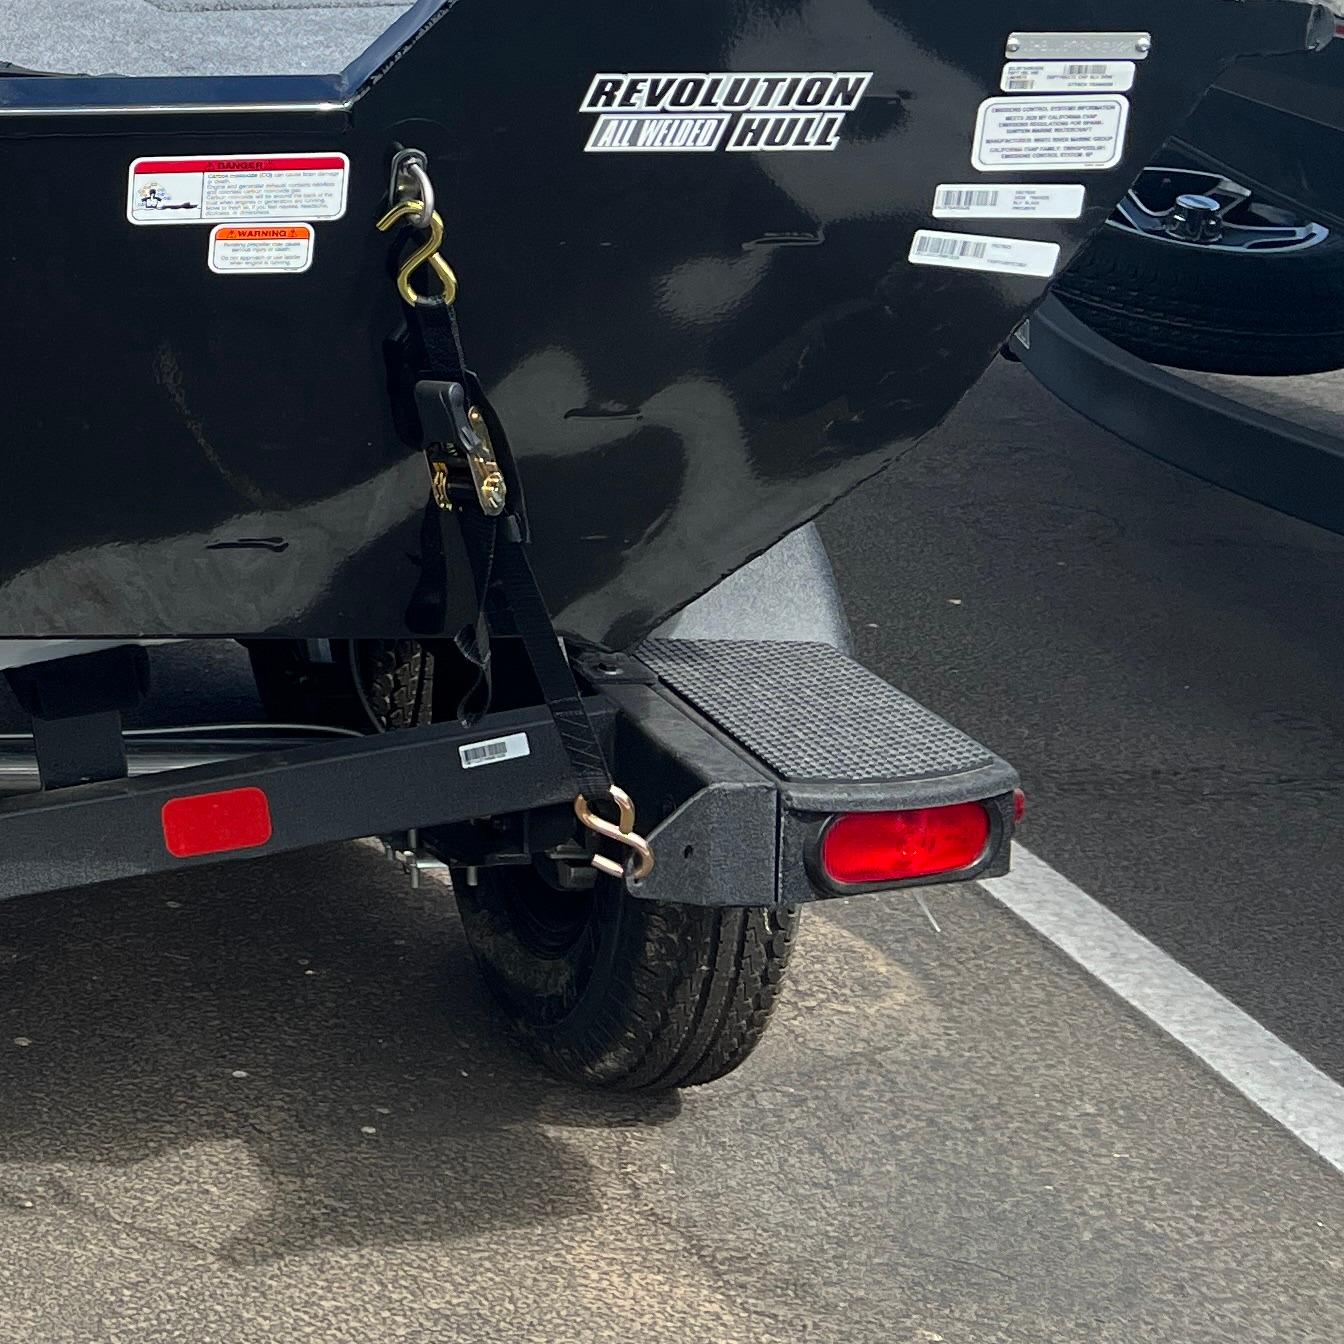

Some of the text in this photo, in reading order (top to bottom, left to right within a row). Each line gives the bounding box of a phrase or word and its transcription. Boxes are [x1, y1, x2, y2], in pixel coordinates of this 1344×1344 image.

[586, 76, 867, 108] REVOLUTION
[598, 116, 840, 147] ALL WELDED HULL
